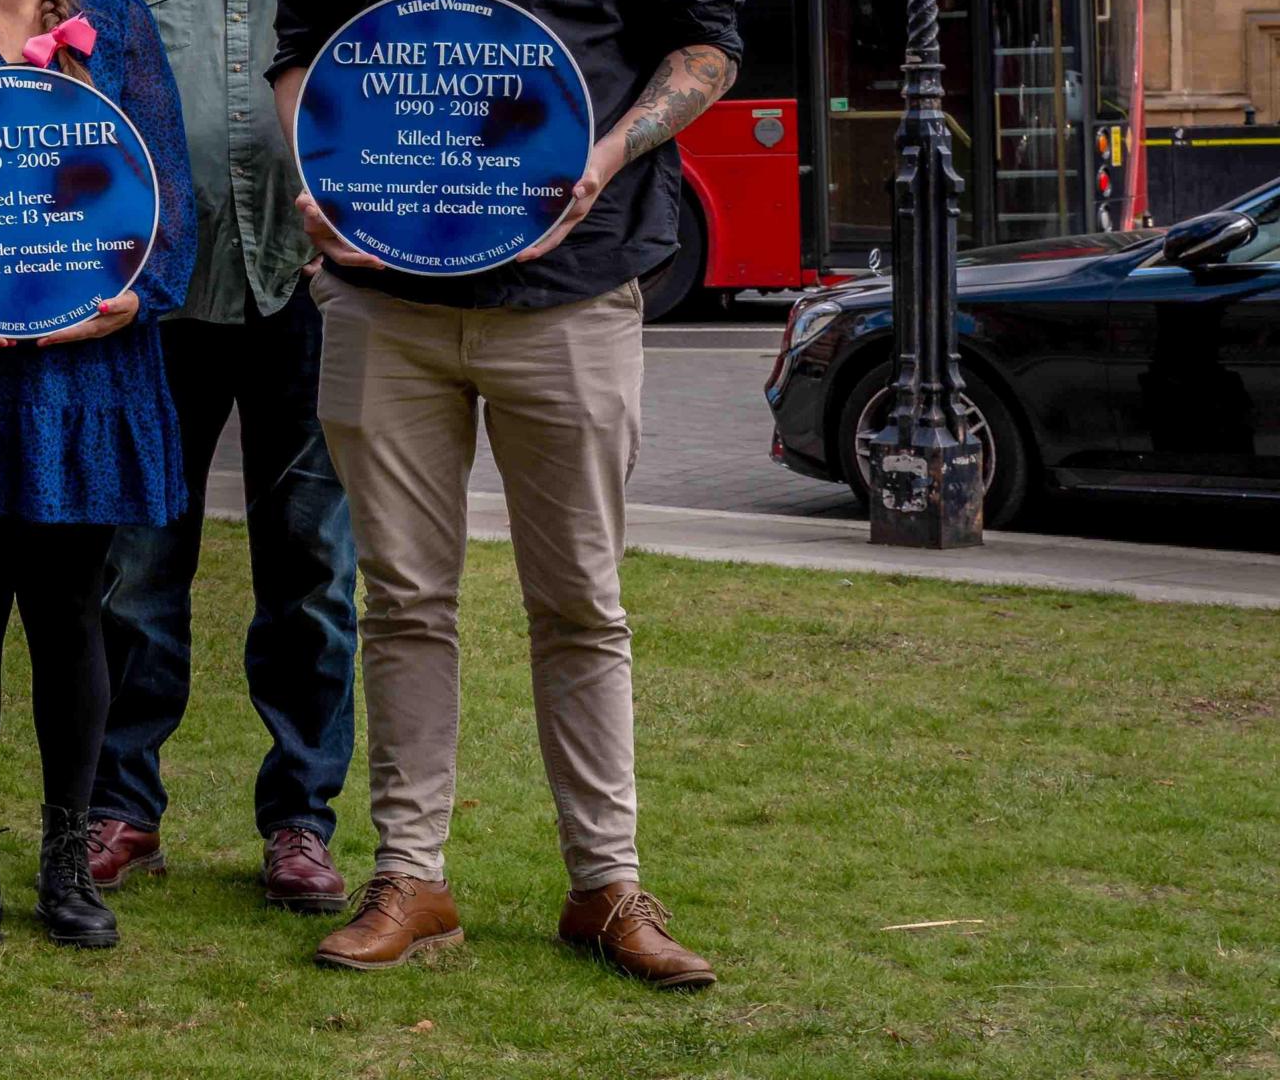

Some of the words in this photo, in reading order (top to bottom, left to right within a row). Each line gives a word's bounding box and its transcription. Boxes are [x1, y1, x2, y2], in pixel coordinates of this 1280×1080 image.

[333, 42, 427, 65] CLAIRE
[433, 42, 554, 67] TAVENER
[362, 72, 522, 100] (WILLMOTT)
[395, 100, 434, 115] 1990
[450, 100, 489, 116] 2018
[398, 130, 441, 146] Killed
[446, 130, 485, 147] here.
[17, 152, 60, 168] 2005
[361, 149, 435, 166] Sentence:
[441, 151, 472, 166] 16.8
[476, 156, 520, 171] years
[319, 178, 344, 192] The
[347, 183, 383, 193] same
[386, 180, 438, 194] murder
[441, 181, 492, 195] outside
[496, 182, 518, 196] the
[522, 182, 563, 197] home
[18, 191, 56, 205] here.
[351, 198, 393, 212] would
[397, 202, 419, 216] get
[422, 204, 430, 213] a
[434, 200, 484, 214] decade
[488, 205, 527, 215] more.
[22, 209, 38, 224] 13
[42, 211, 84, 227] years
